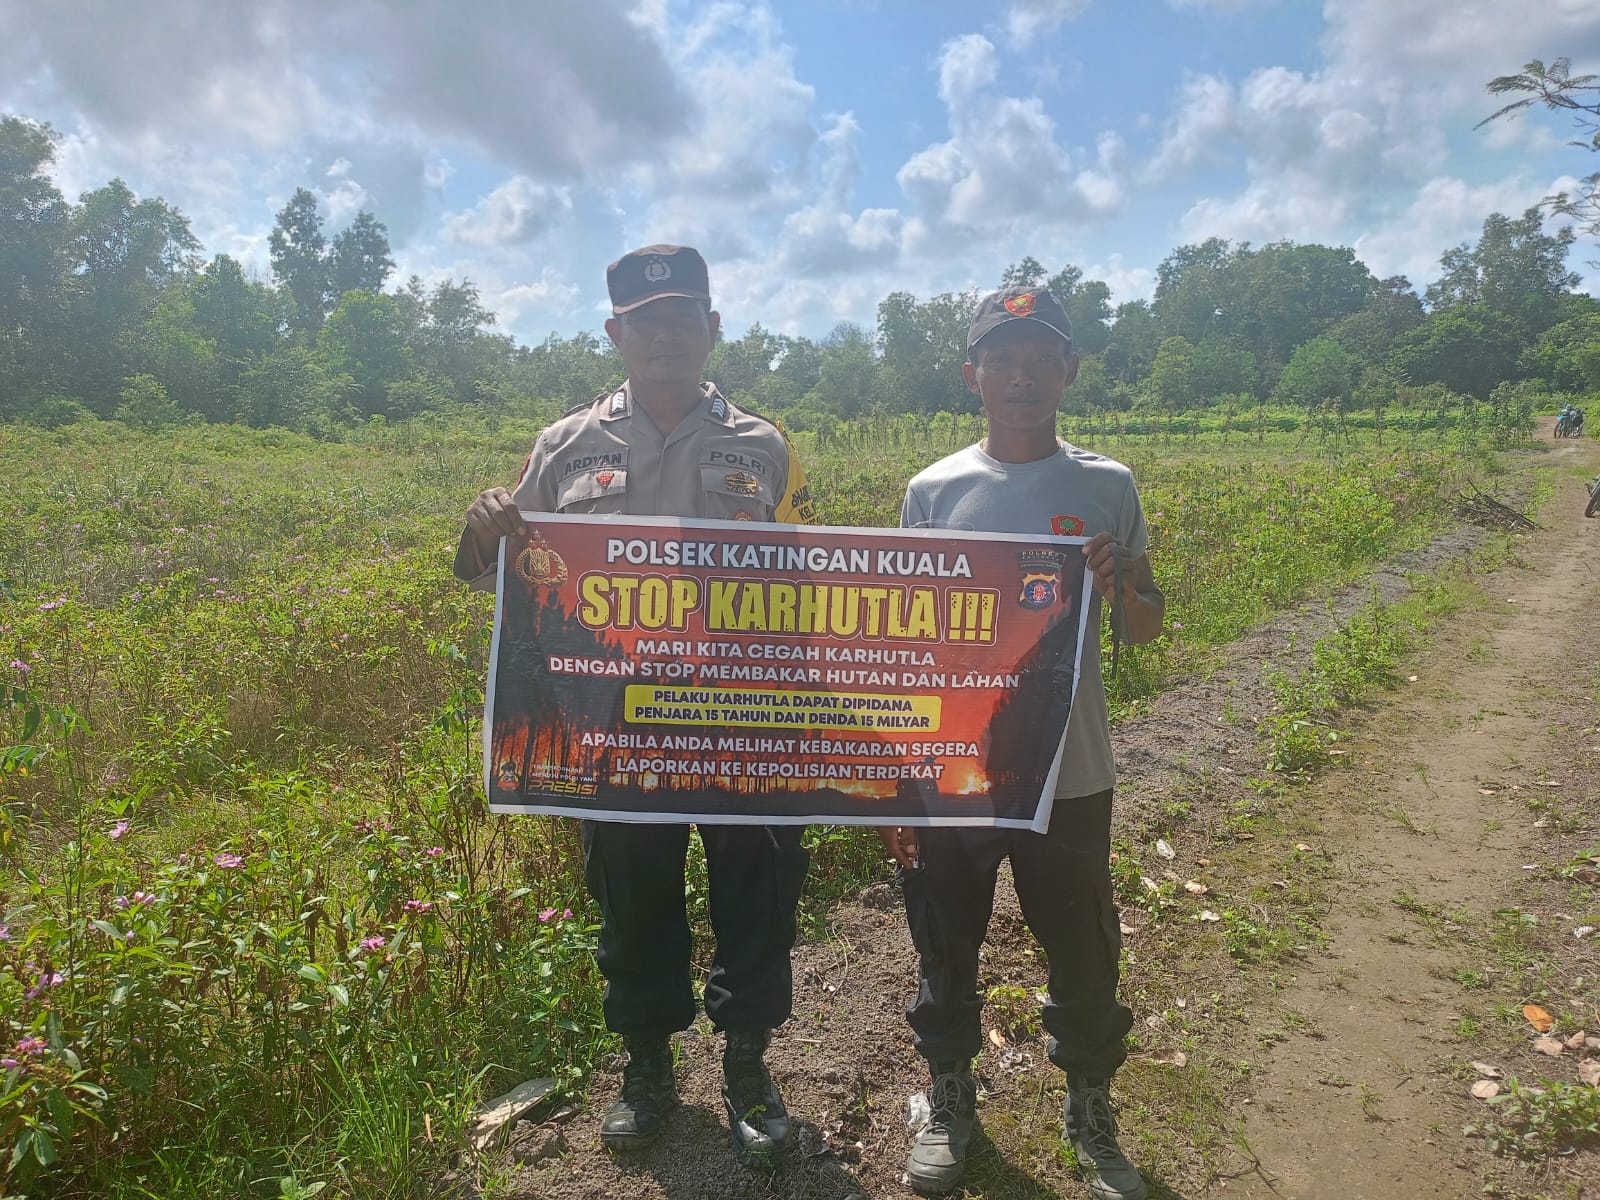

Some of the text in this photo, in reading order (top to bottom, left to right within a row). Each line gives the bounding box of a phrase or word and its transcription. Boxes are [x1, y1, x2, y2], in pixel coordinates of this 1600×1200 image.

[710, 450, 767, 475] POLRI
[607, 539, 972, 578] POLSEK KATINGAN KUALA
[582, 575, 995, 642] STOP KARHUTLA !!!
[636, 639, 936, 666] MARI KITA CEGAH KARHUTLA
[550, 657, 1020, 689] DENGAN STOP MEMBAKAR HUTAN DAN LAHAN
[654, 690, 913, 712] PELAKU KARHUTLA DAPAT DIPIDANA
[635, 706, 930, 728] PENJARA 15 TAHUN DAN DENDA 15 MILYAR
[581, 732, 980, 757] APABILA ANDA MELIHAT KEBAKARAN SEGERA
[616, 758, 944, 780] LAPORKAN KE KEPOLISIAN TERDEKAT
[528, 779, 598, 795] PRESISI
